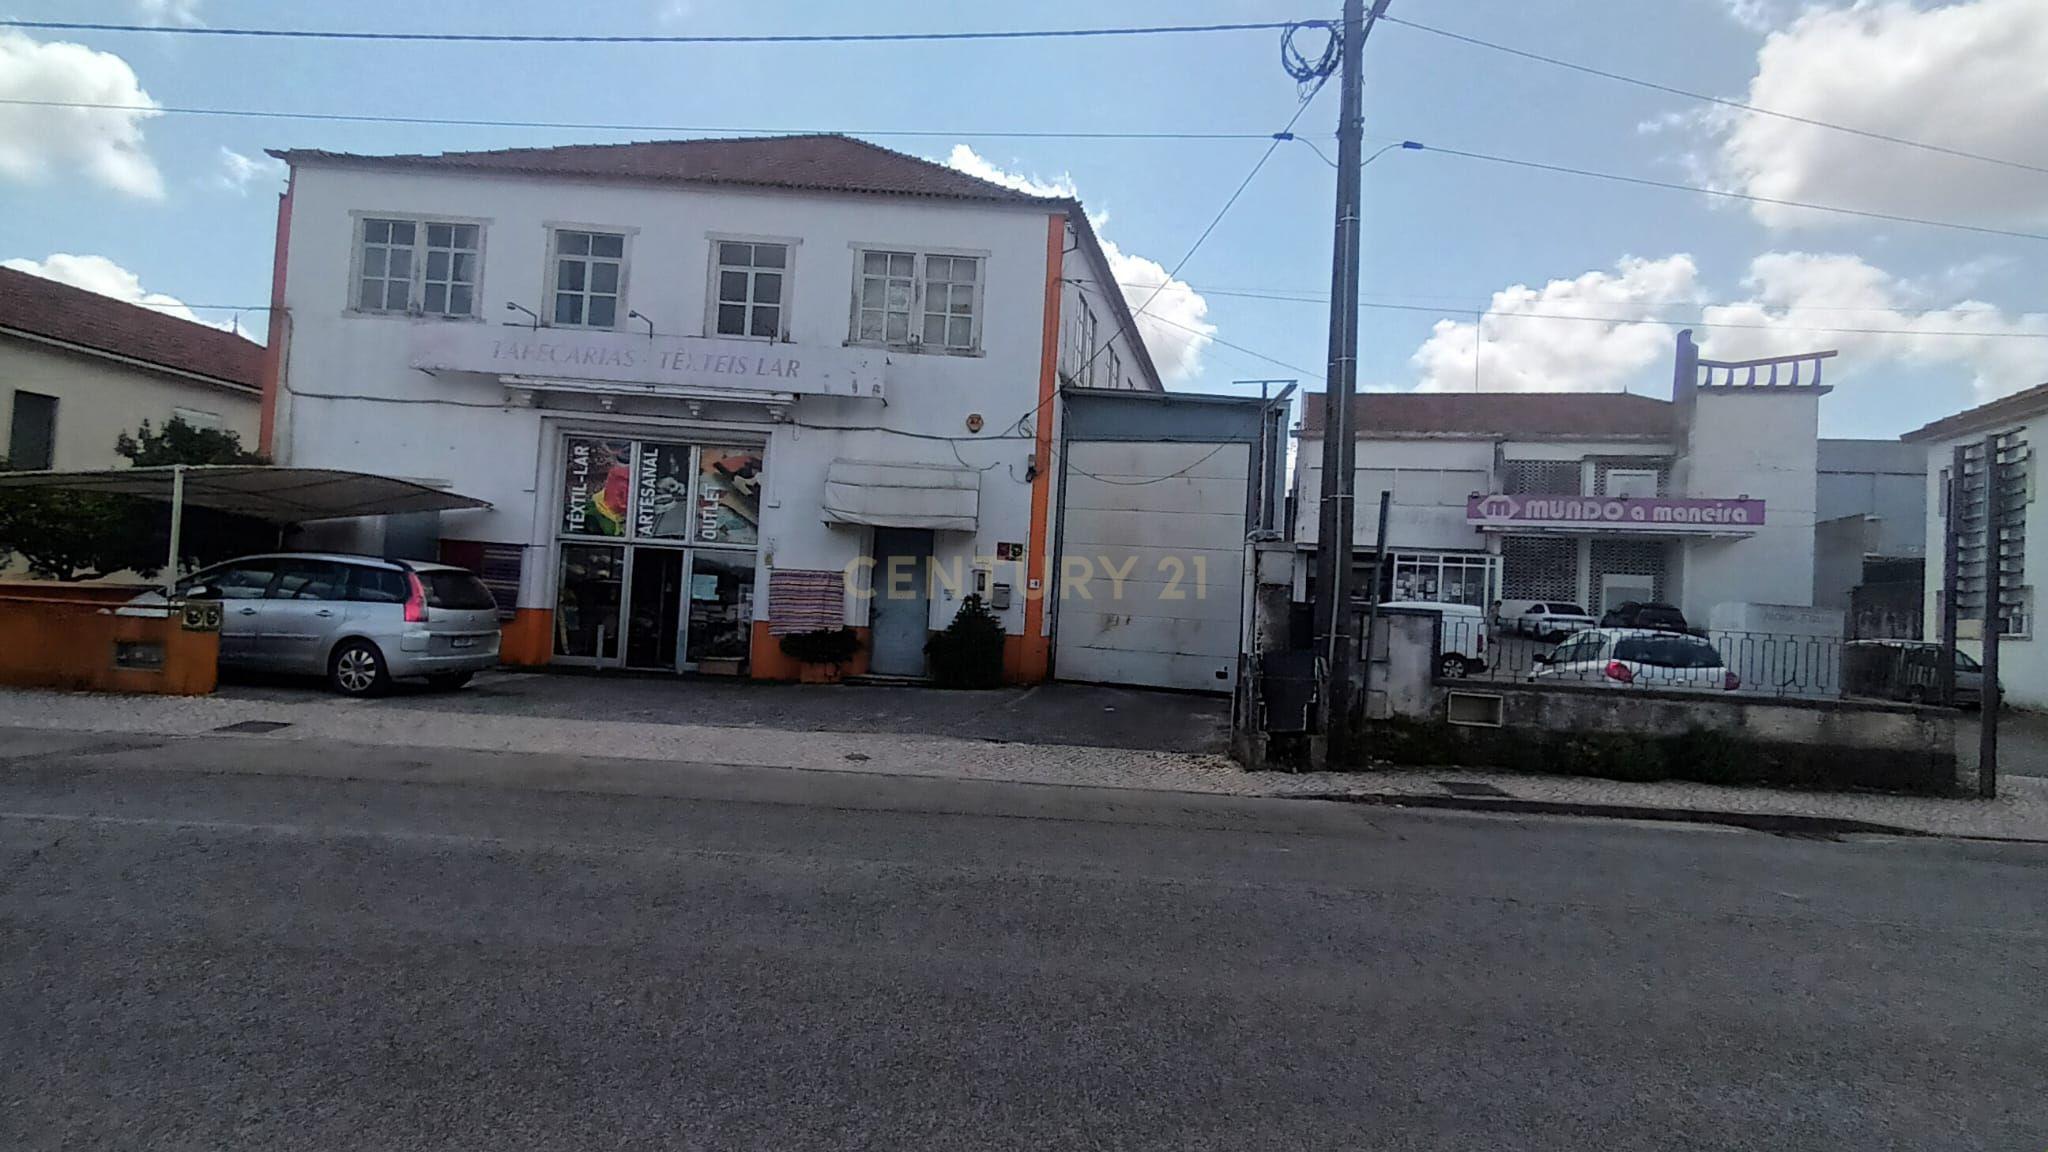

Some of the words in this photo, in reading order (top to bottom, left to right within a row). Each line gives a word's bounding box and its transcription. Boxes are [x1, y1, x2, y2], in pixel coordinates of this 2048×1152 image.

[755, 358, 800, 378] LAR
[639, 448, 658, 536] ARTESANAL
[701, 484, 720, 540] OUTLET
